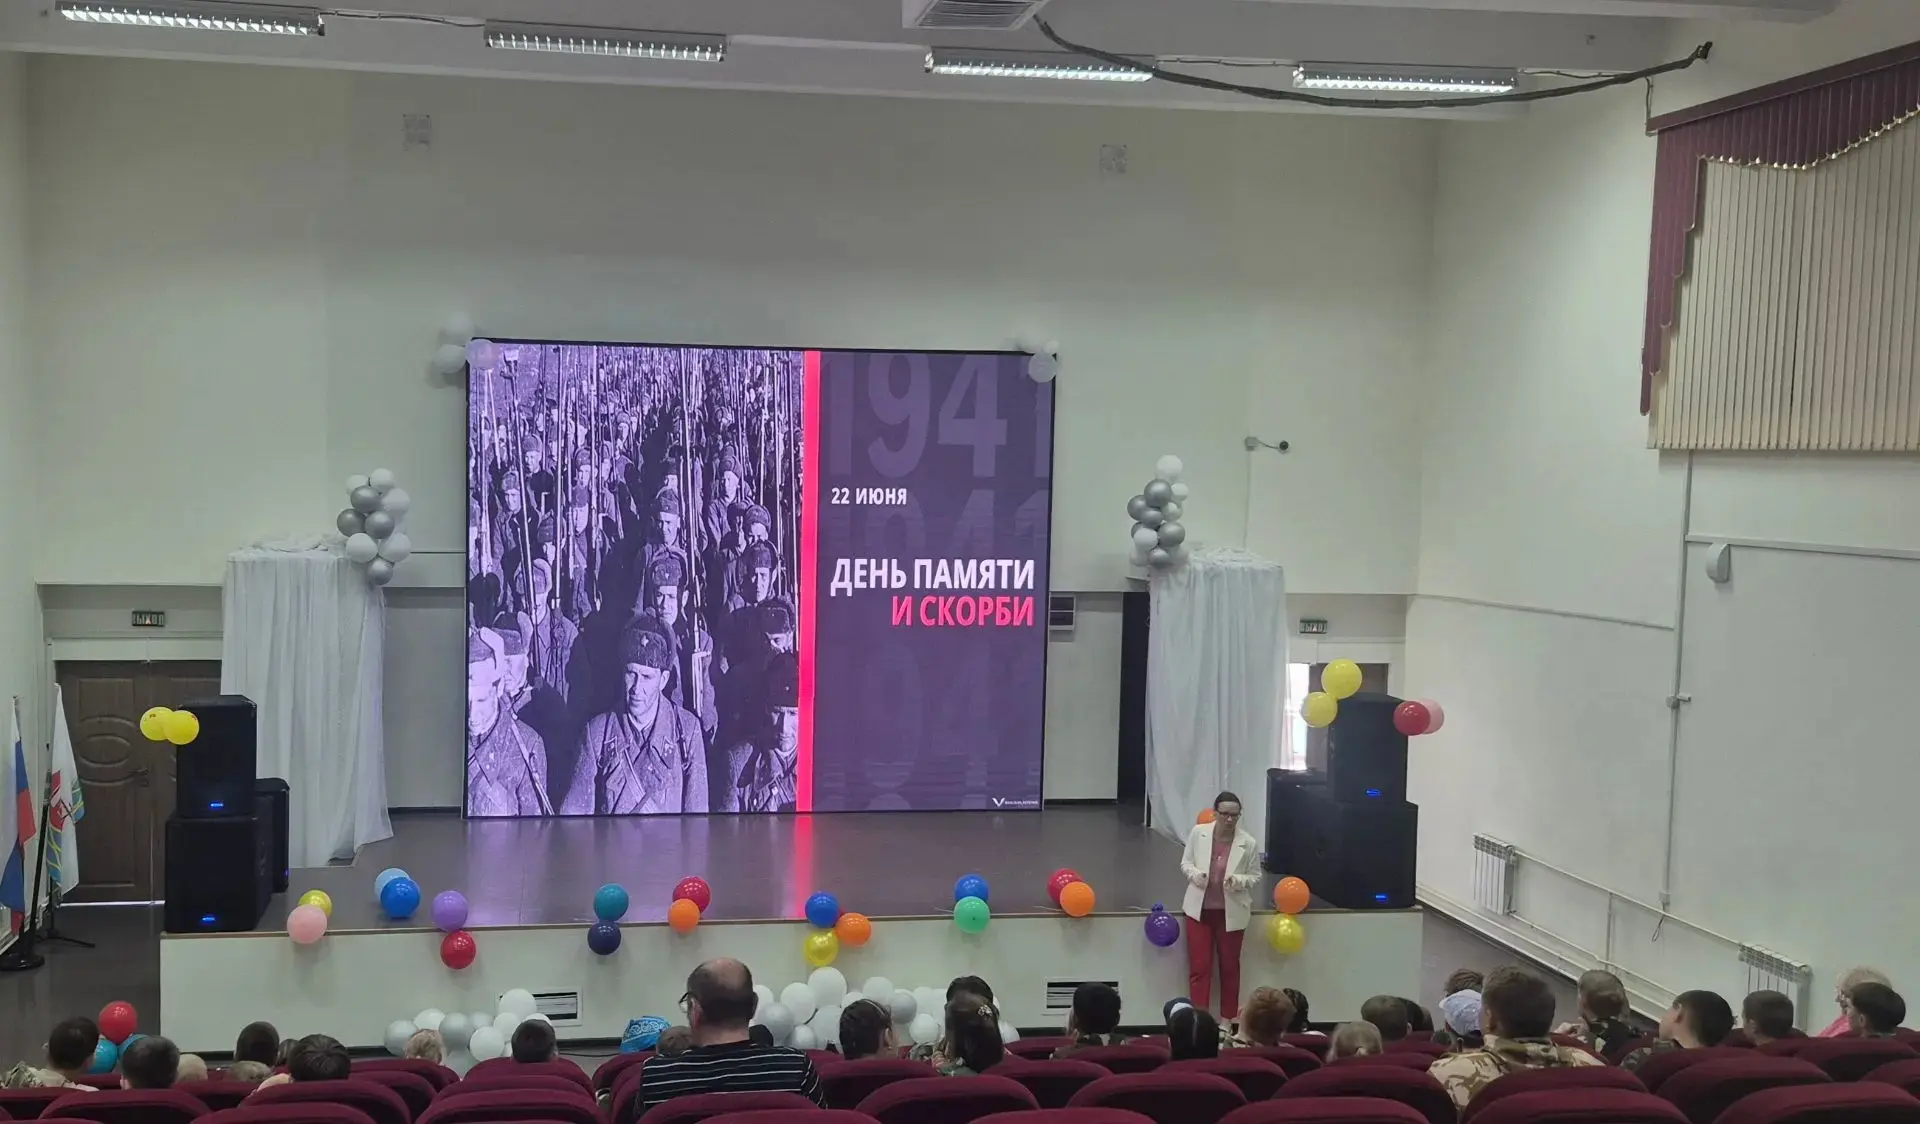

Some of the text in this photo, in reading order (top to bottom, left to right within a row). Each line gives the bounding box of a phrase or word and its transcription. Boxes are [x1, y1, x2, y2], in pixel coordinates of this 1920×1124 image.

[831, 487, 908, 505] 22 ИЮНЯ
[830, 558, 1035, 597] ДЕНЬ ПАМЯТИ
[892, 595, 1034, 627] И СКОРБИ
